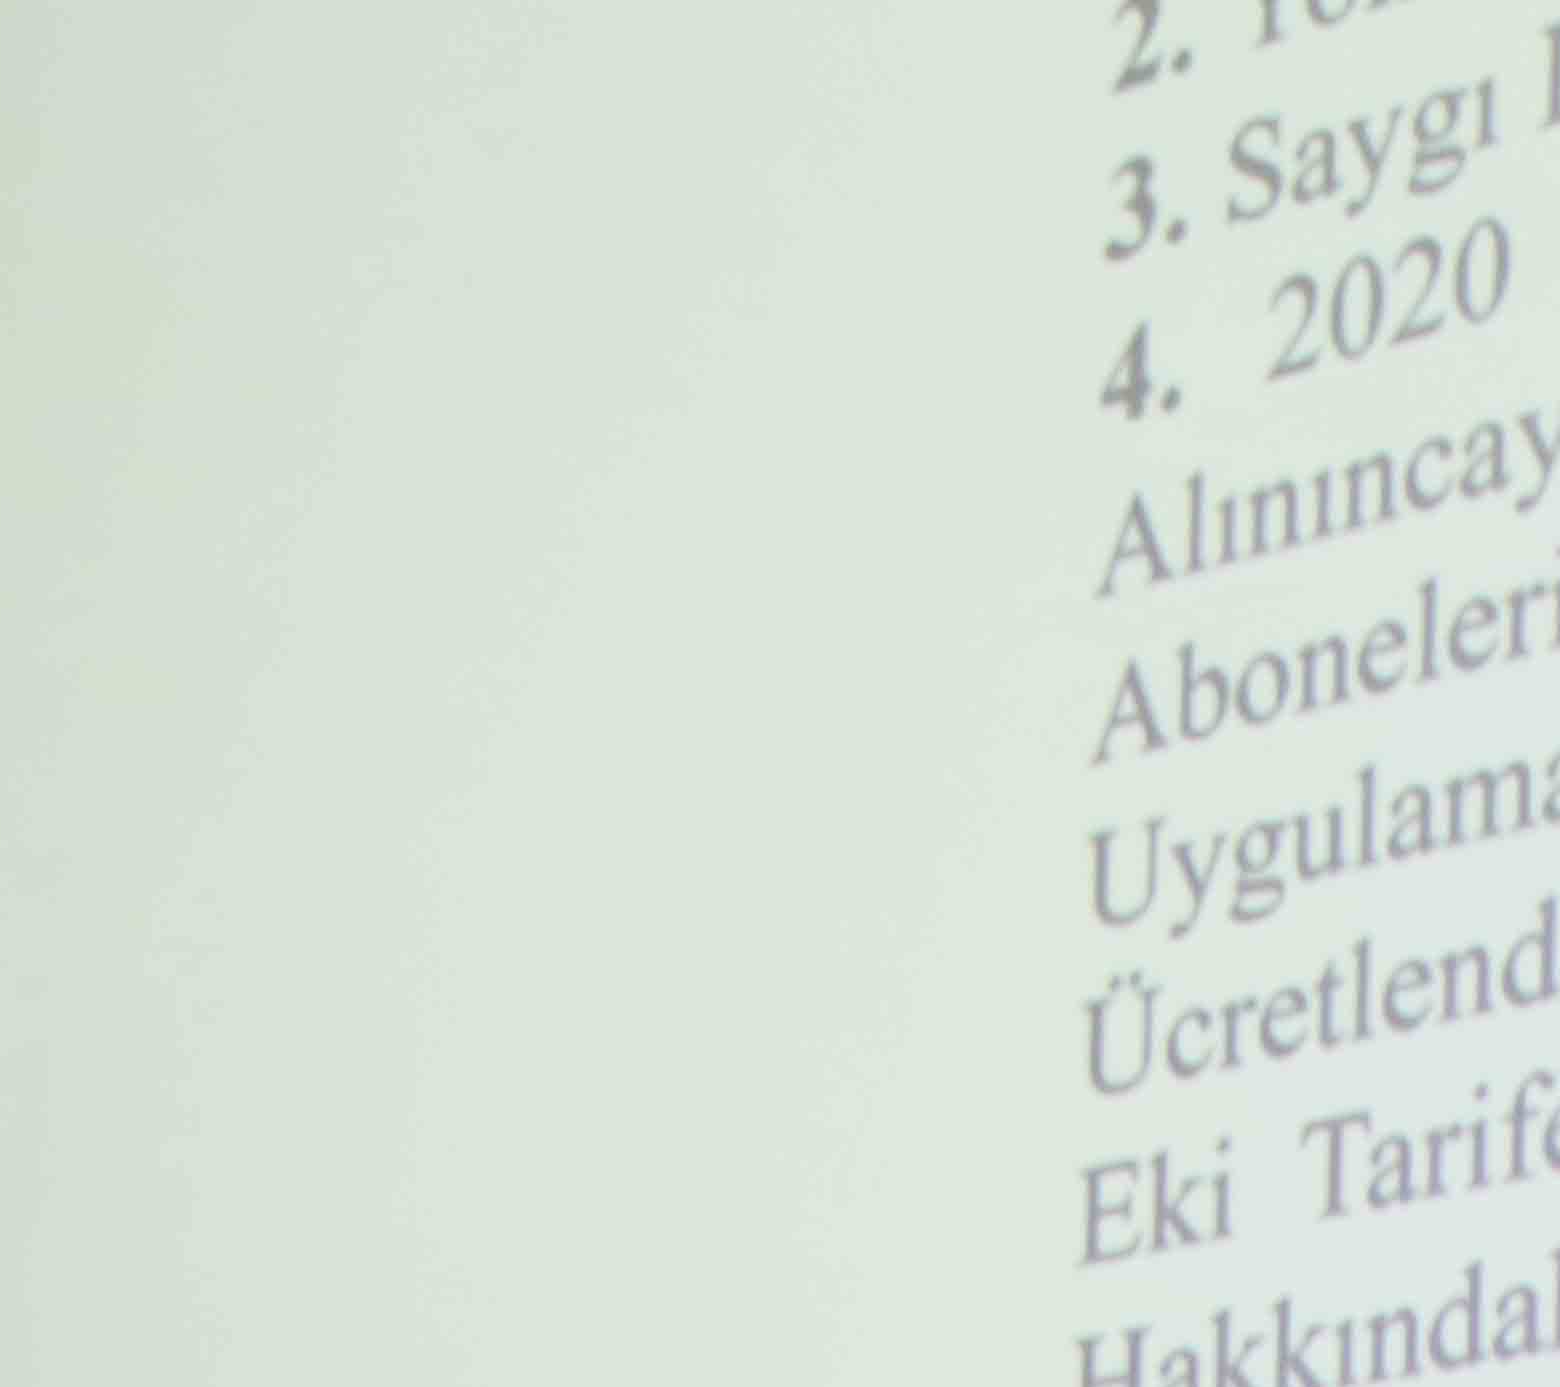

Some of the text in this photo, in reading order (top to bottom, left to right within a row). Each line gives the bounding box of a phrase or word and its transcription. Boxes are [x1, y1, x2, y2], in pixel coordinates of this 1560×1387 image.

[1111, 0, 1194, 95] 2.
[1102, 153, 1189, 264] 3.
[1225, 76, 1498, 225] Saygı
[1099, 321, 1183, 422] 4.
[1266, 215, 1512, 382] 2020
[1078, 1135, 1233, 1268] Eki
